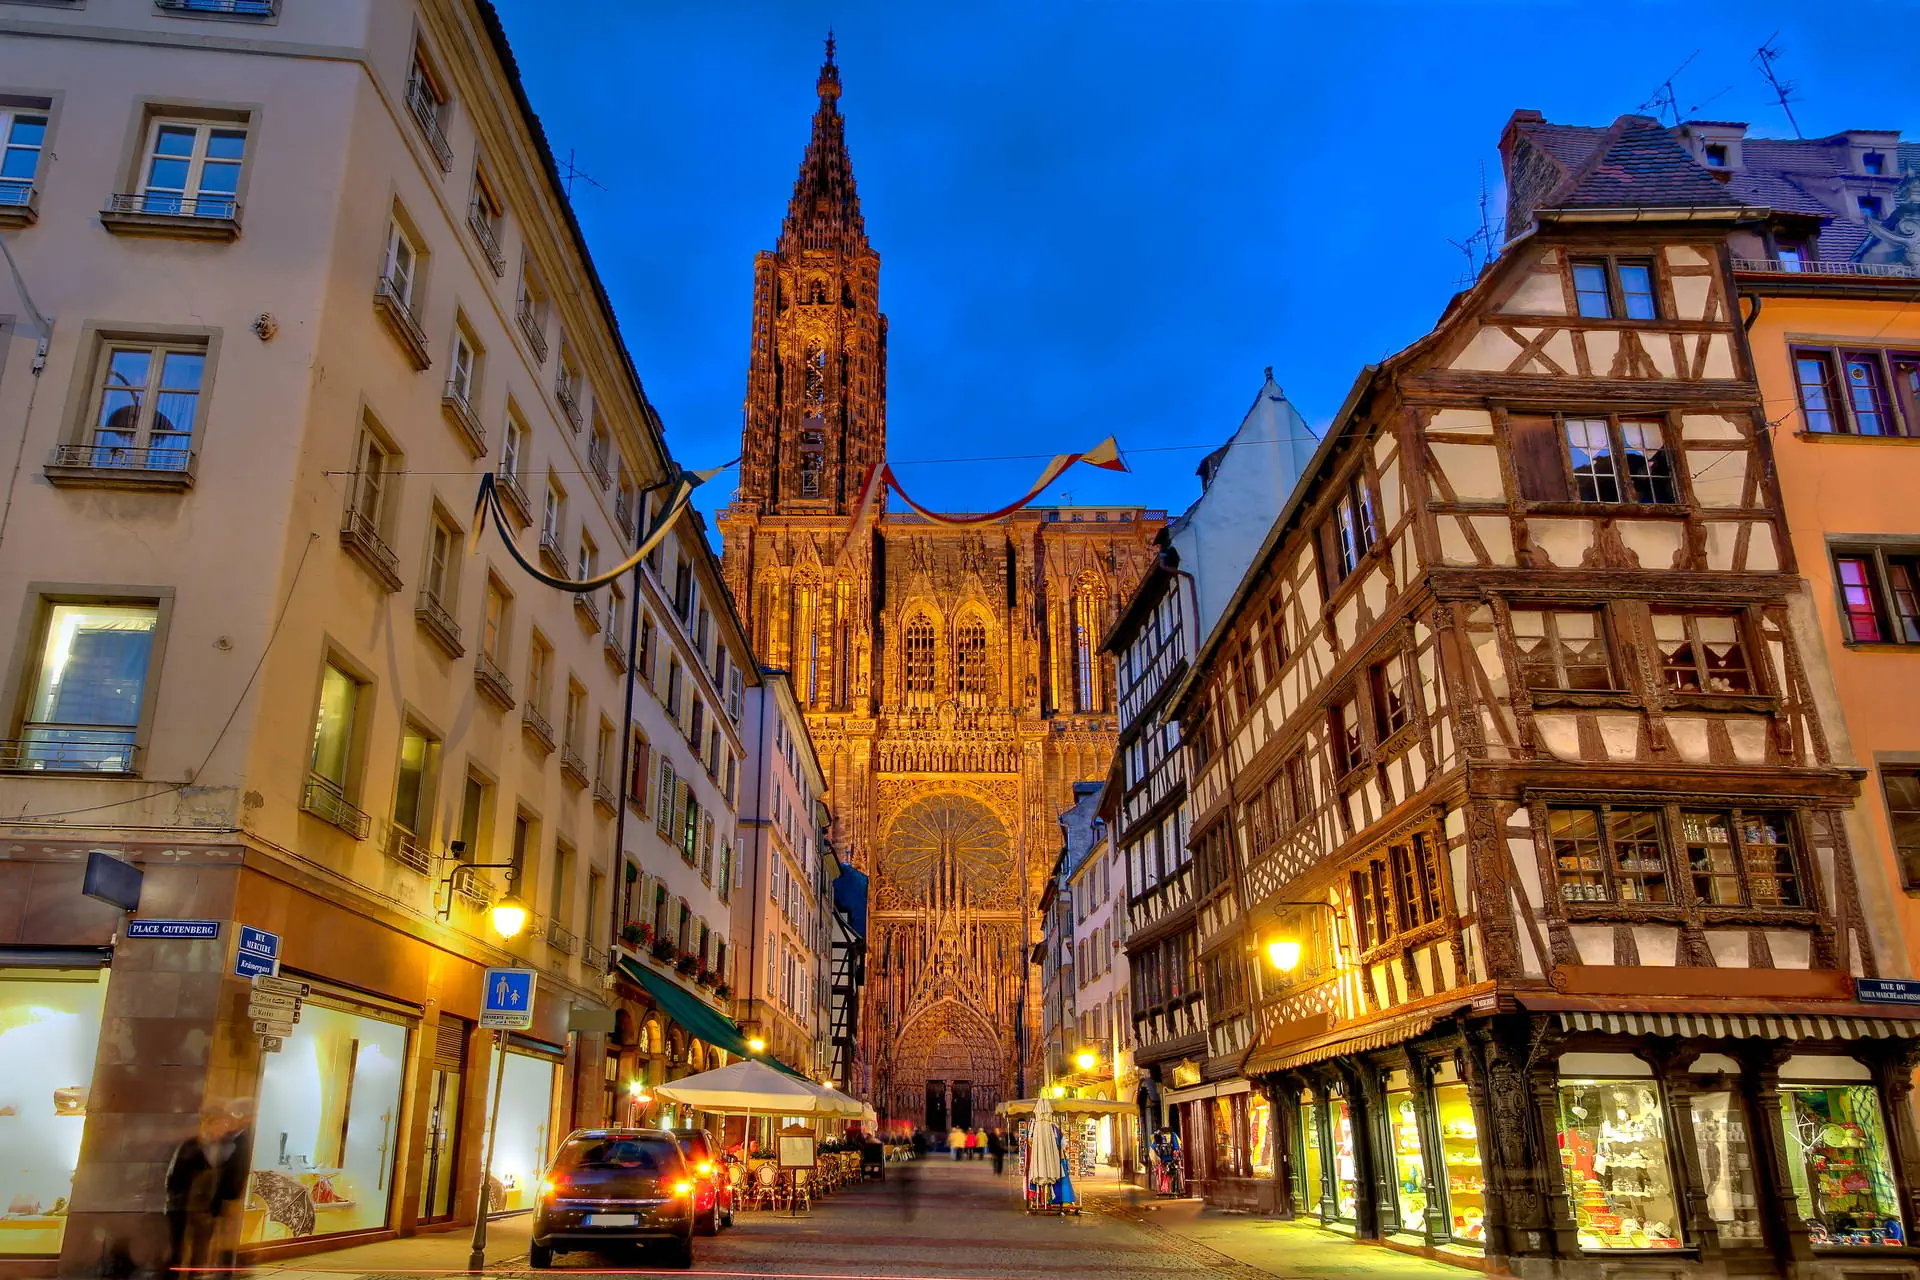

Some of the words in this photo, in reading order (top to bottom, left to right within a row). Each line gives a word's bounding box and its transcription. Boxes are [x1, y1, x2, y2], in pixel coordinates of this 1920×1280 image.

[132, 925, 160, 933] PLACE
[162, 925, 214, 934] GUTENBERG
[255, 933, 265, 942] RUE
